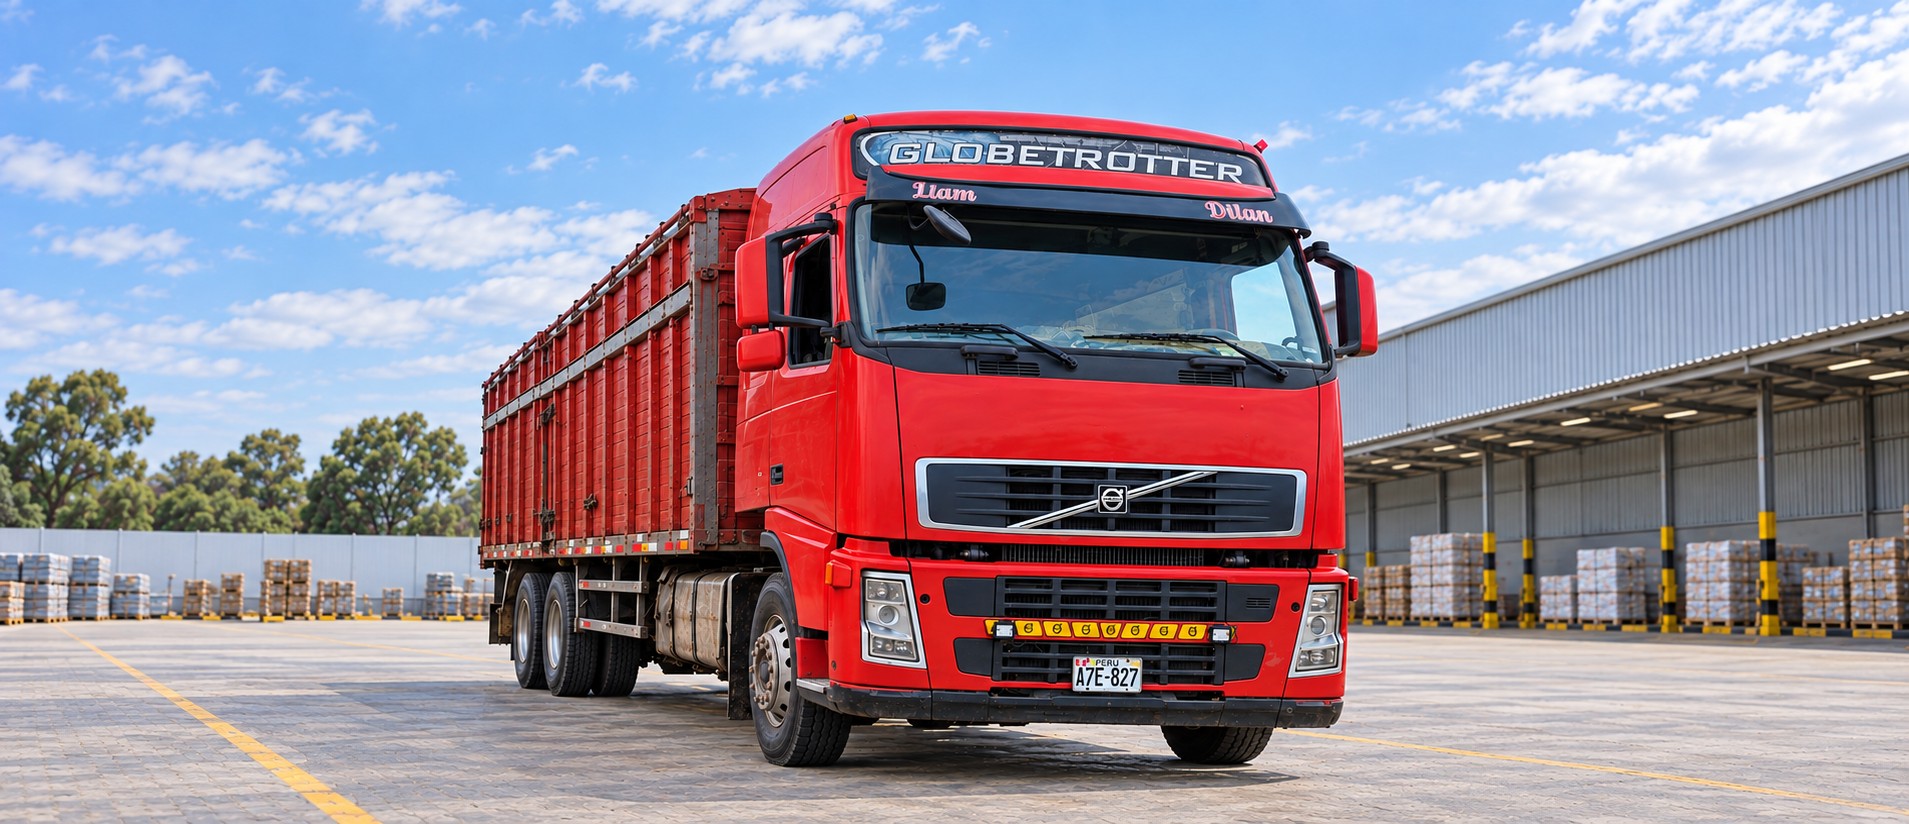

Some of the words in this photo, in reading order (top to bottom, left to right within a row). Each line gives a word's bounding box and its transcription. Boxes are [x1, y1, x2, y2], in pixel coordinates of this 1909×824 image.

[889, 141, 1243, 183] GLOBETROTTER
[1204, 200, 1273, 223] Dilan
[1095, 659, 1119, 667] PERU
[1076, 667, 1138, 687] A7E-827
